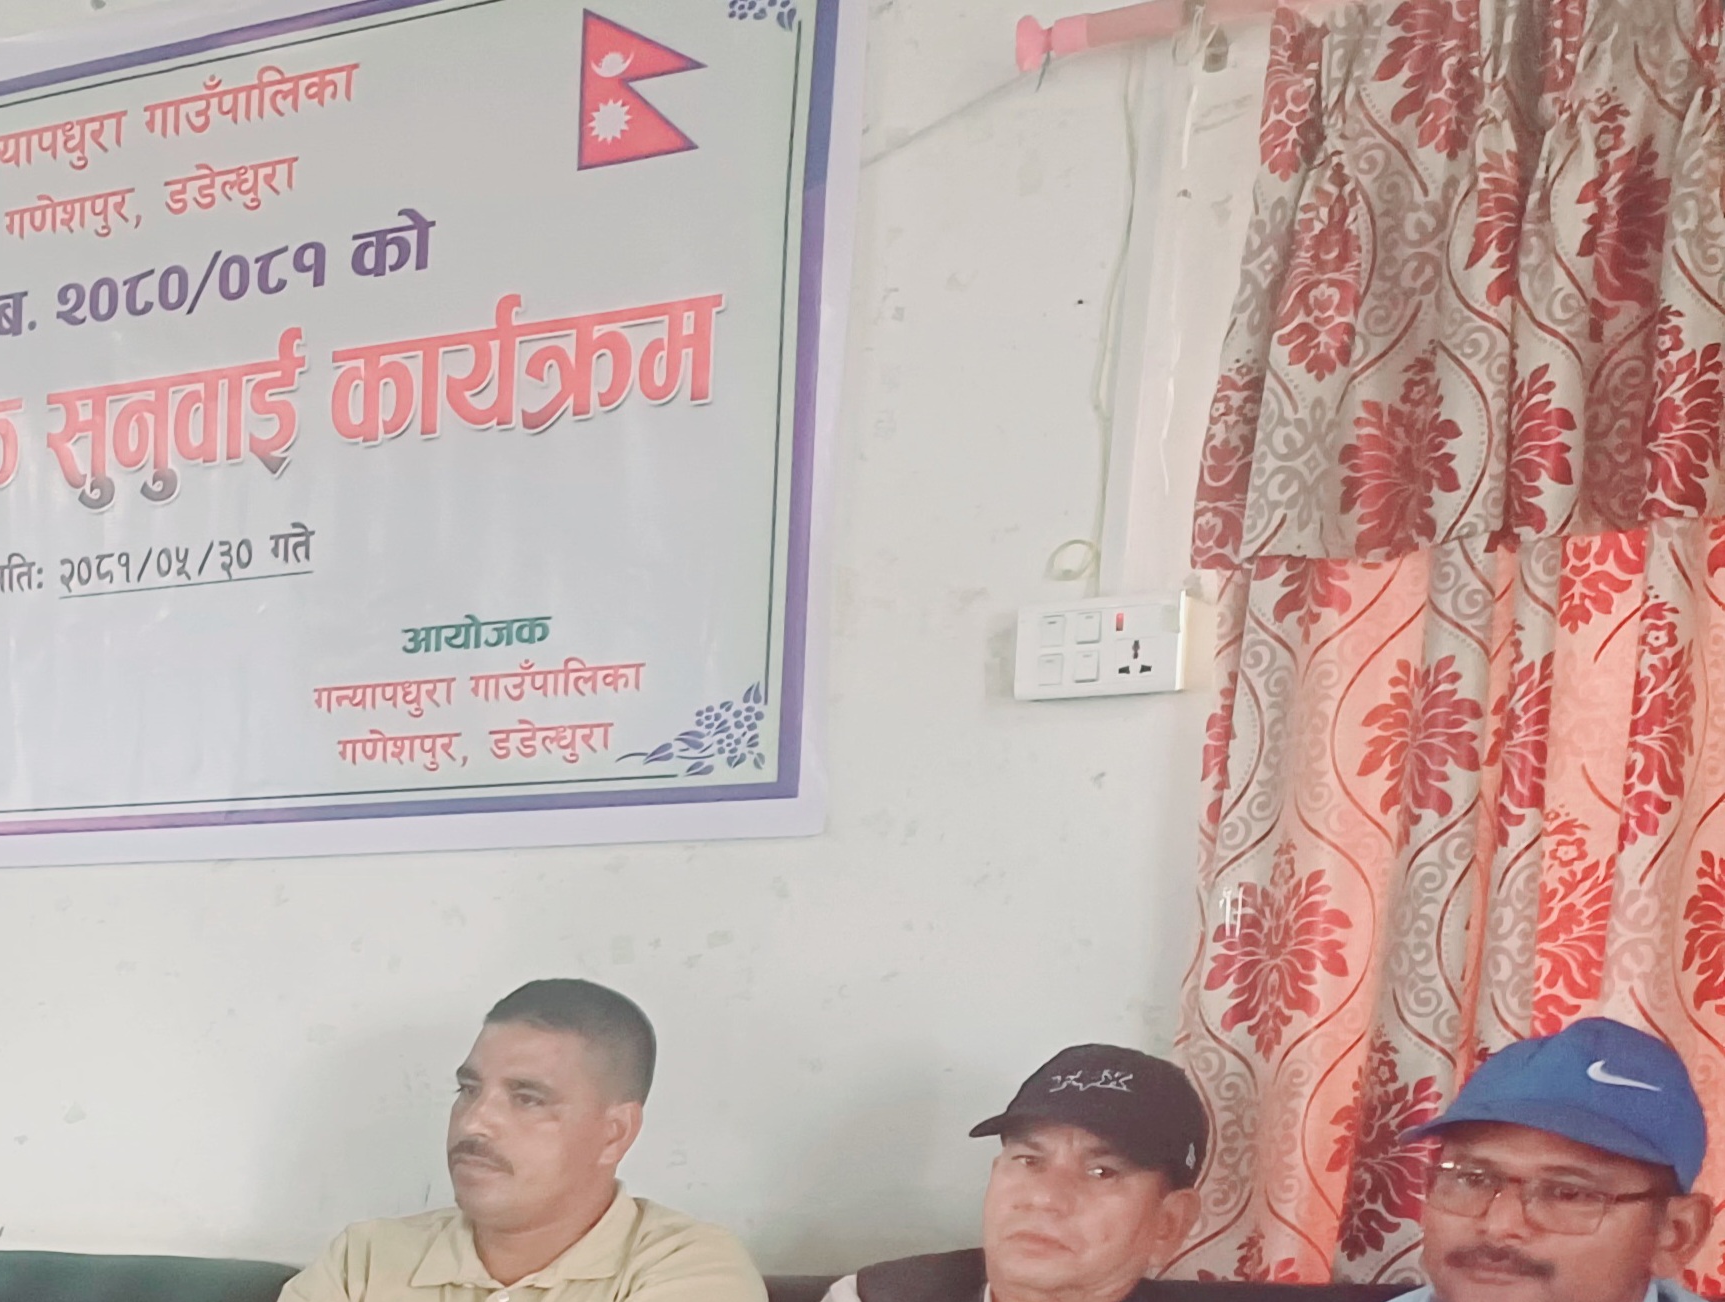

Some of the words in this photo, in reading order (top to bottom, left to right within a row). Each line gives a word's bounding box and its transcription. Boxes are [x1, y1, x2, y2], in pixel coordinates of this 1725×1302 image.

[144, 63, 360, 138] गाउँपालिका
[5, 188, 141, 239] गणेशपुर,
[164, 157, 299, 215] डडेल्धुरा
[56, 242, 326, 326] २०८०/०८१
[351, 208, 436, 277] को
[47, 328, 307, 509] सुनुवाई
[332, 294, 725, 448] कार्यक्रम
[60, 539, 253, 593] २०८१/०५/३०
[270, 522, 315, 563] गते
[401, 614, 552, 654] आयोजक
[313, 677, 456, 718] गन्यापधुरा
[470, 657, 646, 701] गाउँपालिका
[337, 729, 468, 771] गणेशपुर,
[488, 719, 614, 763] डडेल्धुरा
